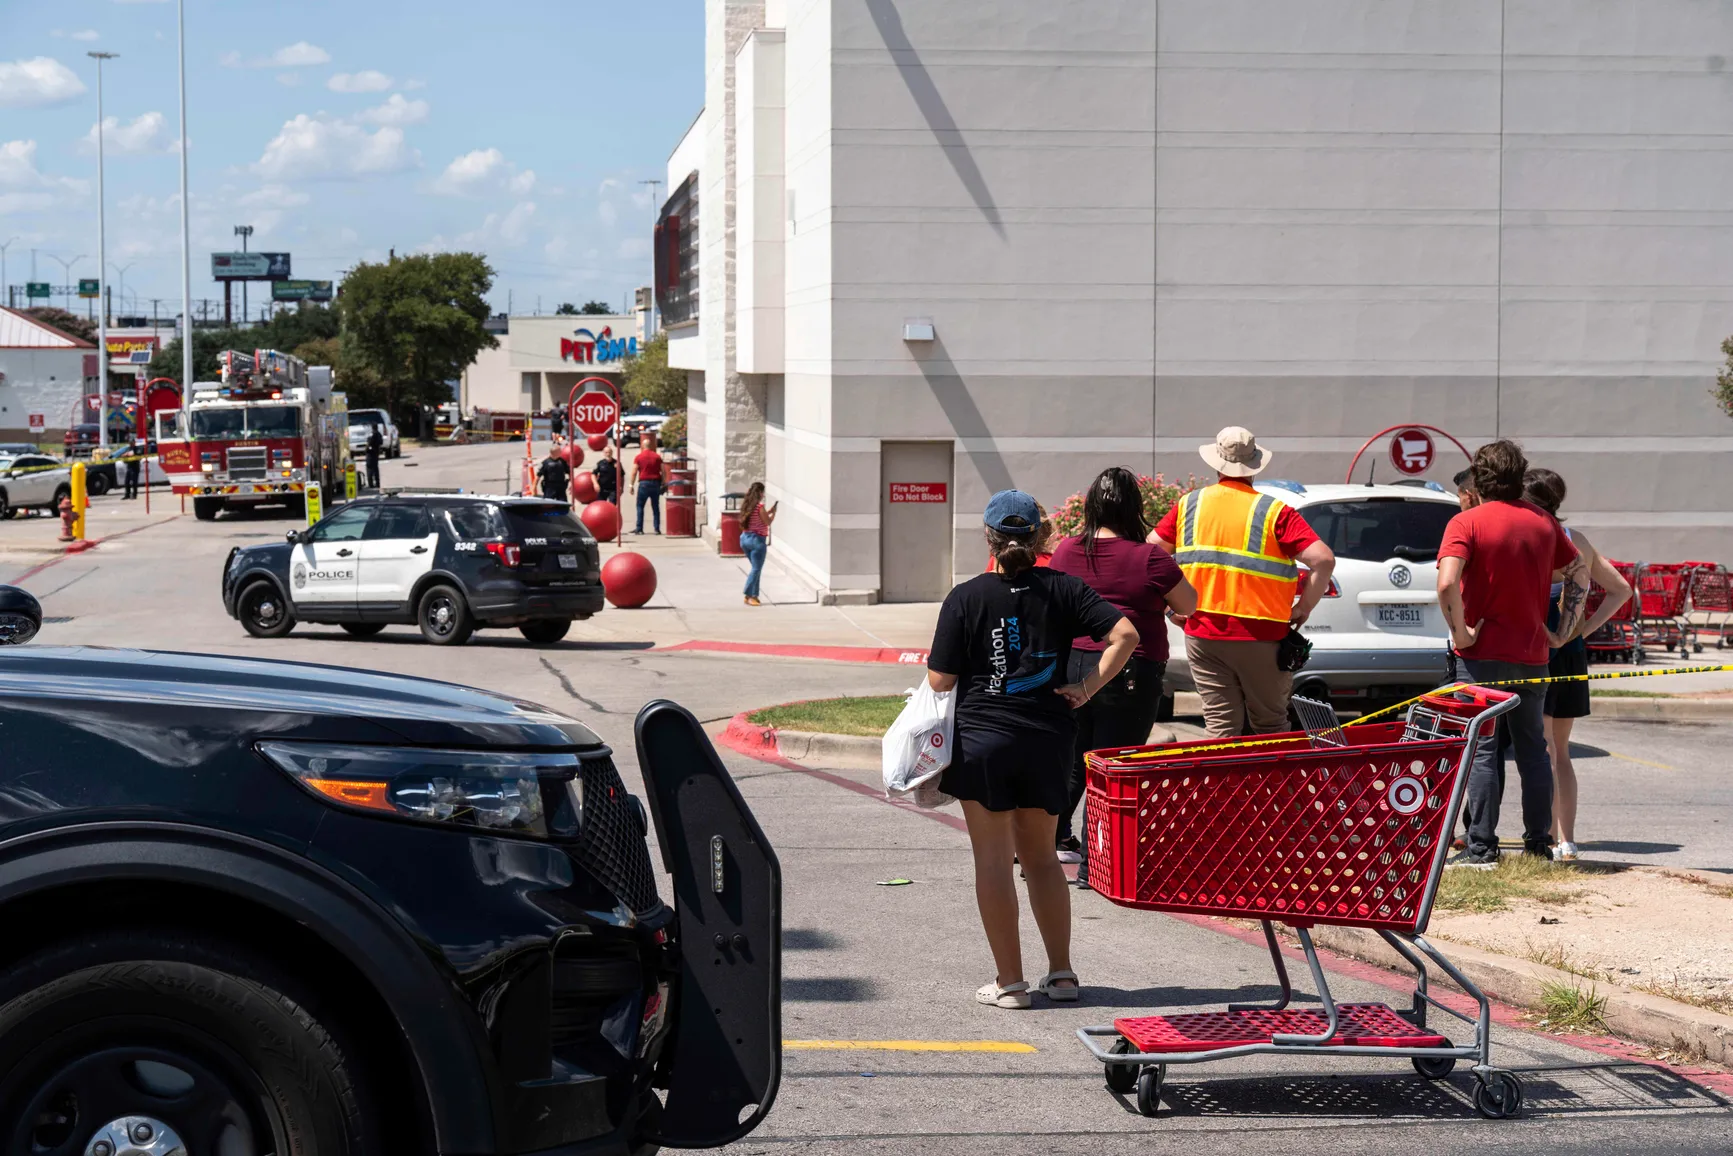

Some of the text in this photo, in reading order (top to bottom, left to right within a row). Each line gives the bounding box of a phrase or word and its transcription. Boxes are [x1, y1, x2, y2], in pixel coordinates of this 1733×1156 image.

[560, 336, 637, 362] PETSMA
[576, 405, 614, 422] STOP
[893, 493, 944, 501] Do Not Block
[454, 542, 477, 551] 9342
[308, 571, 355, 579] POLICE
[1007, 616, 1021, 651] 2024
[899, 653, 921, 662] FIRE
